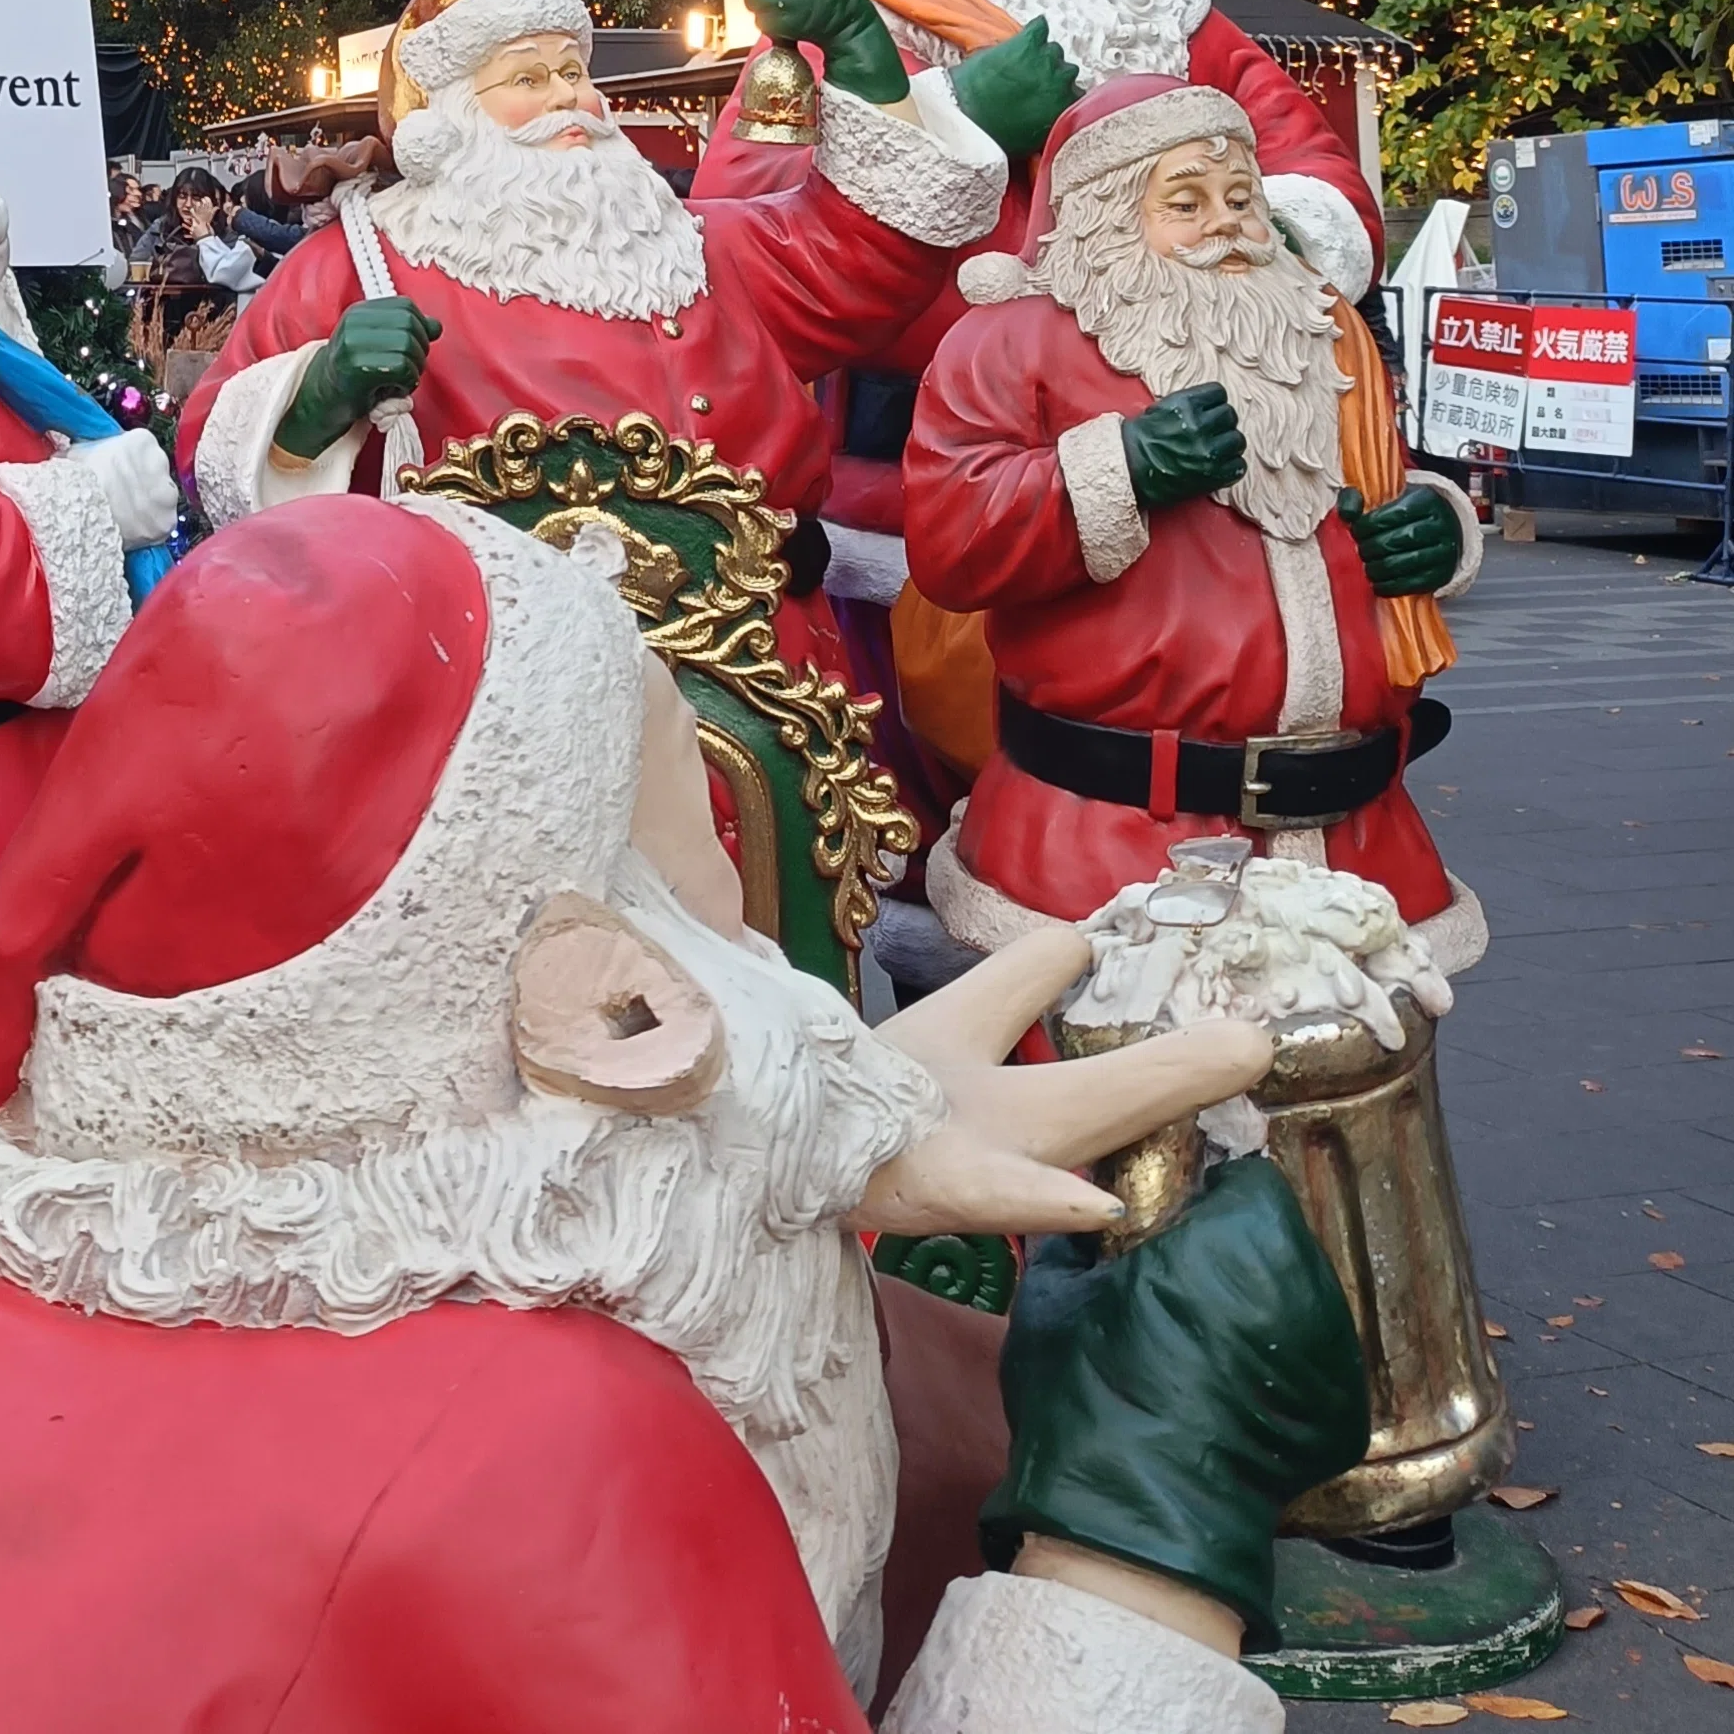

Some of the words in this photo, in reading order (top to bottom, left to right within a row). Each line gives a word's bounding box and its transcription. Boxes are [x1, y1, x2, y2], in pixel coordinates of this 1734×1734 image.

[1438, 315, 1523, 355] 立入禁止
[1531, 326, 1629, 364] 火気厳禁
[1434, 370, 1520, 408] 少量危険物
[1430, 399, 1515, 438] 貯蔵取扱所
[1531, 426, 1567, 440] 最大数量
